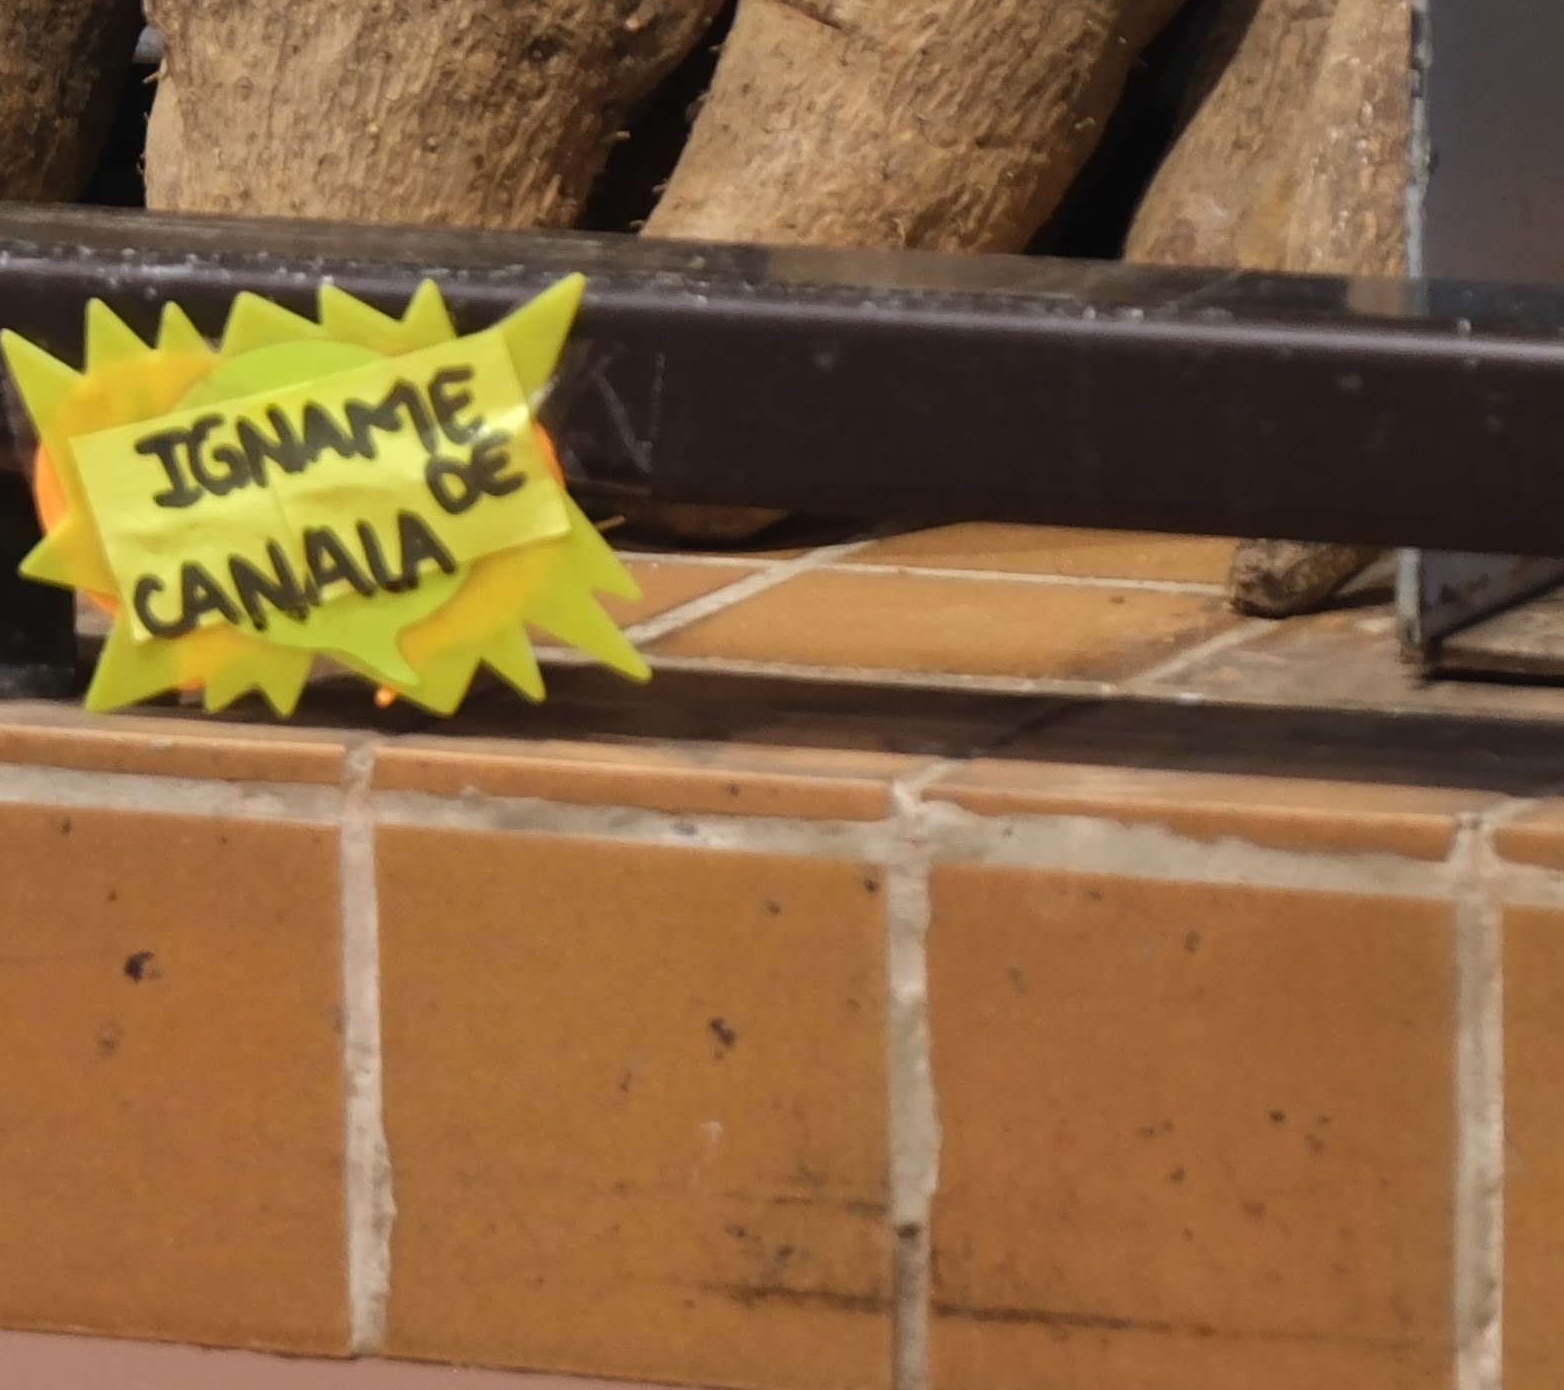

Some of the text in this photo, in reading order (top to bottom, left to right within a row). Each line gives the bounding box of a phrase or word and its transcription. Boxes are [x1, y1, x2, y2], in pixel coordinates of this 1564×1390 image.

[136, 364, 482, 509] IGNAME
[425, 431, 528, 514] DE
[132, 510, 457, 638] CANALA
